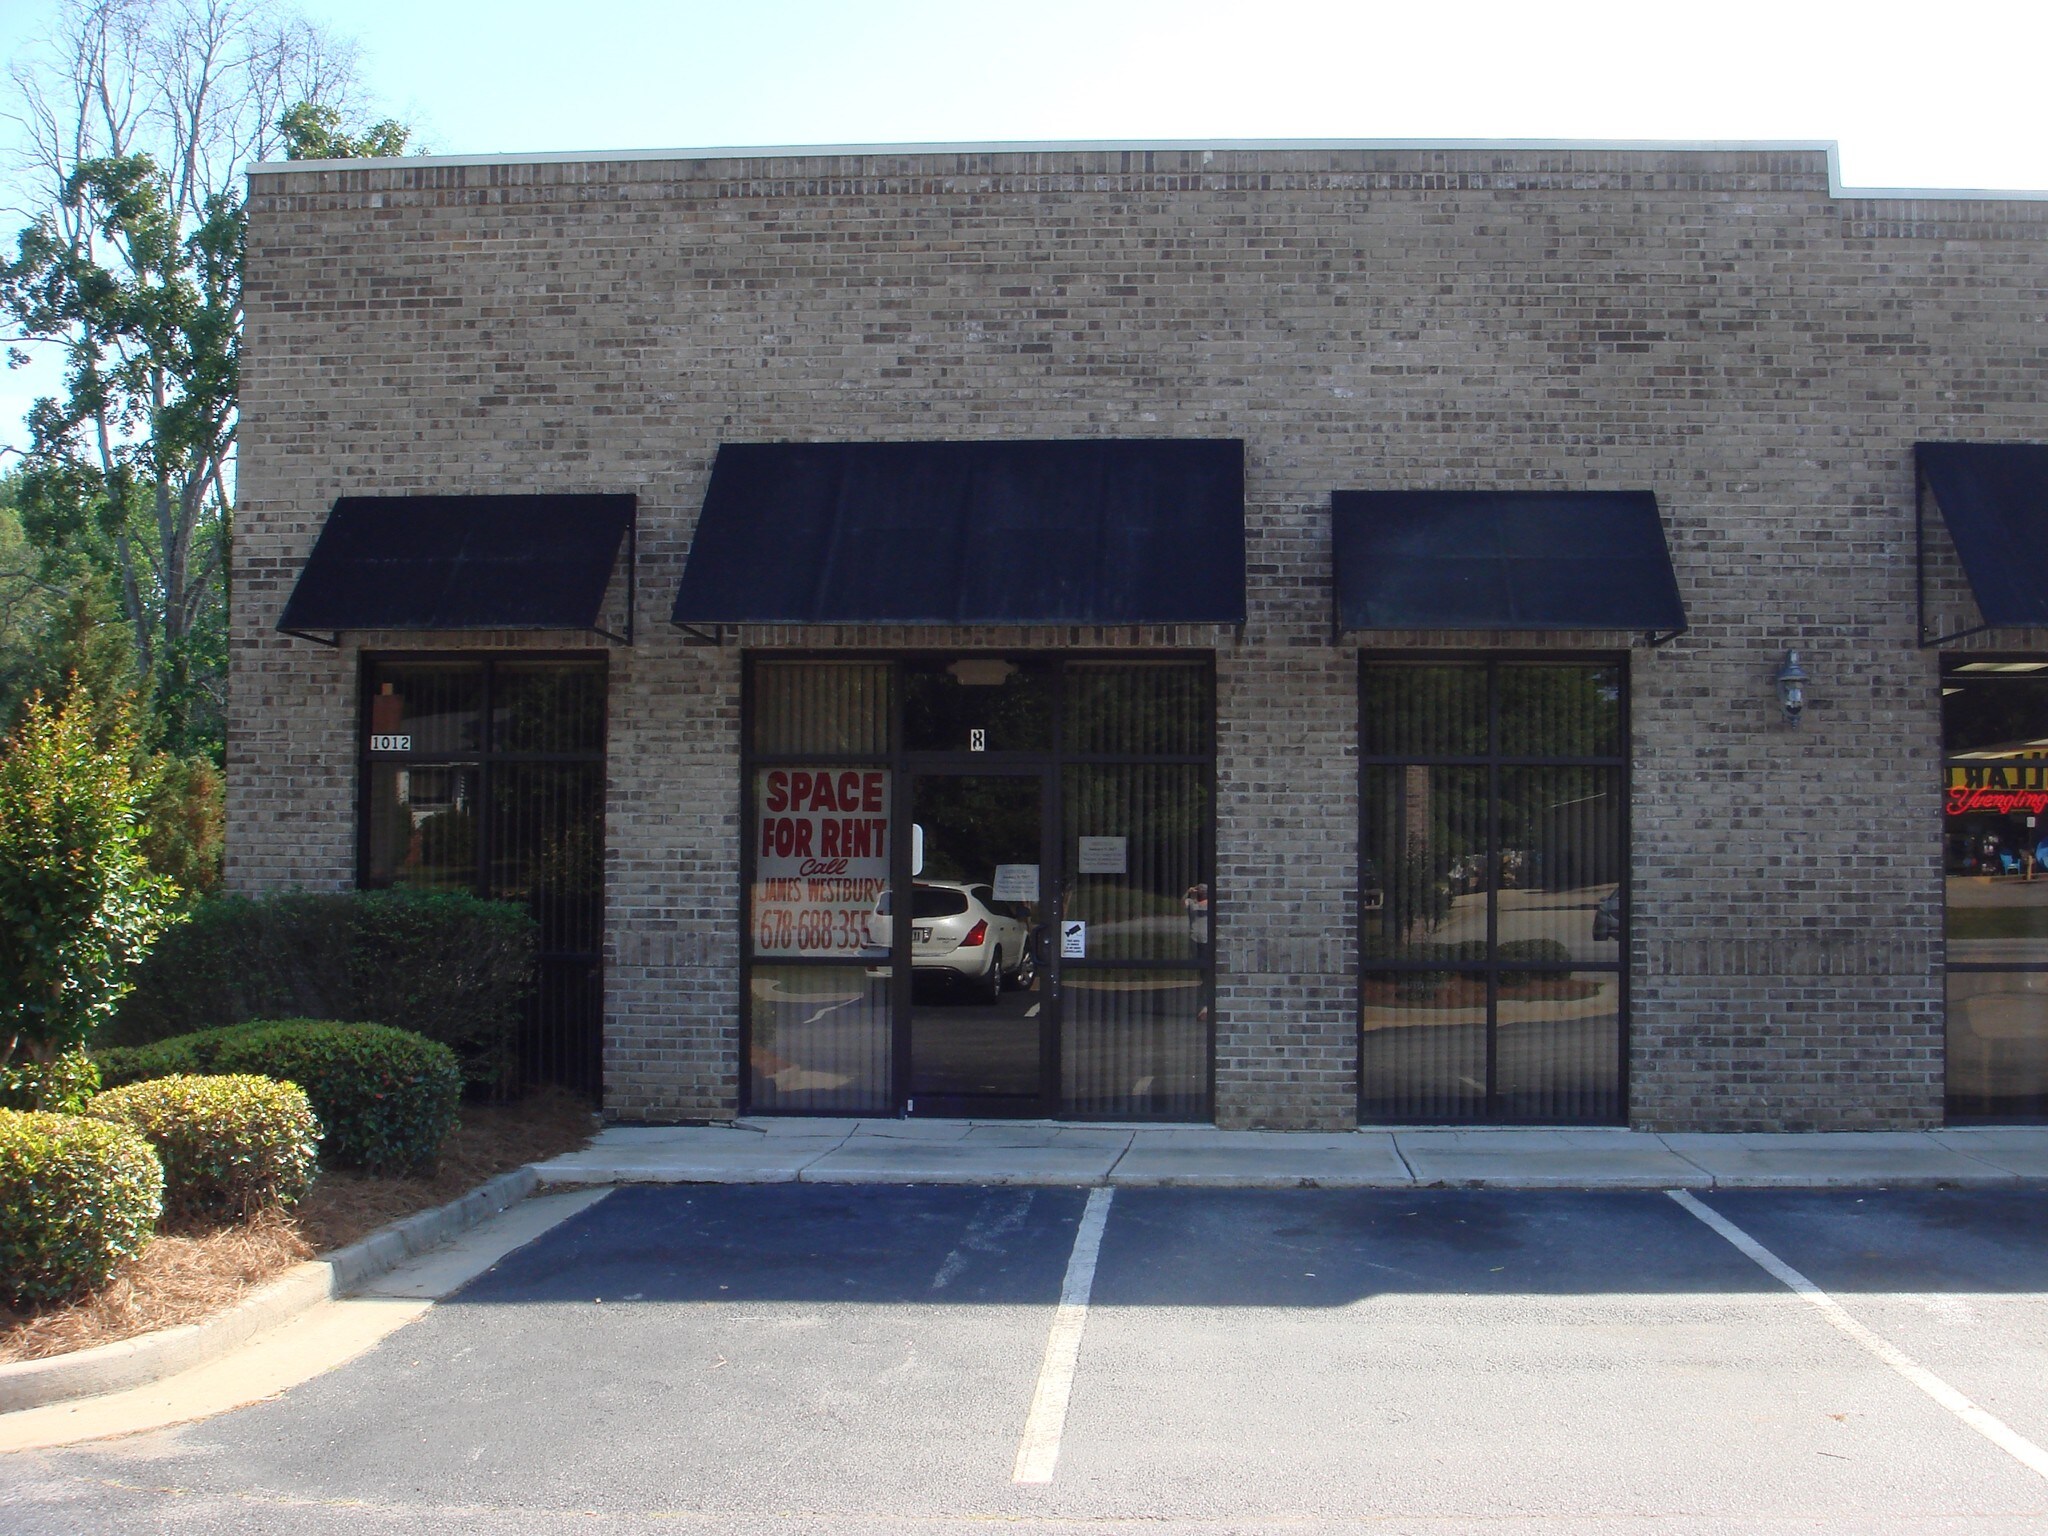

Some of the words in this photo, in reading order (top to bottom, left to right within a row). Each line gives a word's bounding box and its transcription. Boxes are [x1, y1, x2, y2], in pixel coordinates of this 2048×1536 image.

[372, 736, 410, 750] 1012
[766, 771, 883, 812] SPACE
[1946, 785, 2048, 815] Yuengling
[762, 817, 813, 858] FOR
[821, 818, 887, 858] RENT
[800, 858, 848, 877] Call
[760, 878, 802, 902] JAMES
[808, 878, 885, 903] WESTBURY
[760, 909, 884, 950] 678-688-355
